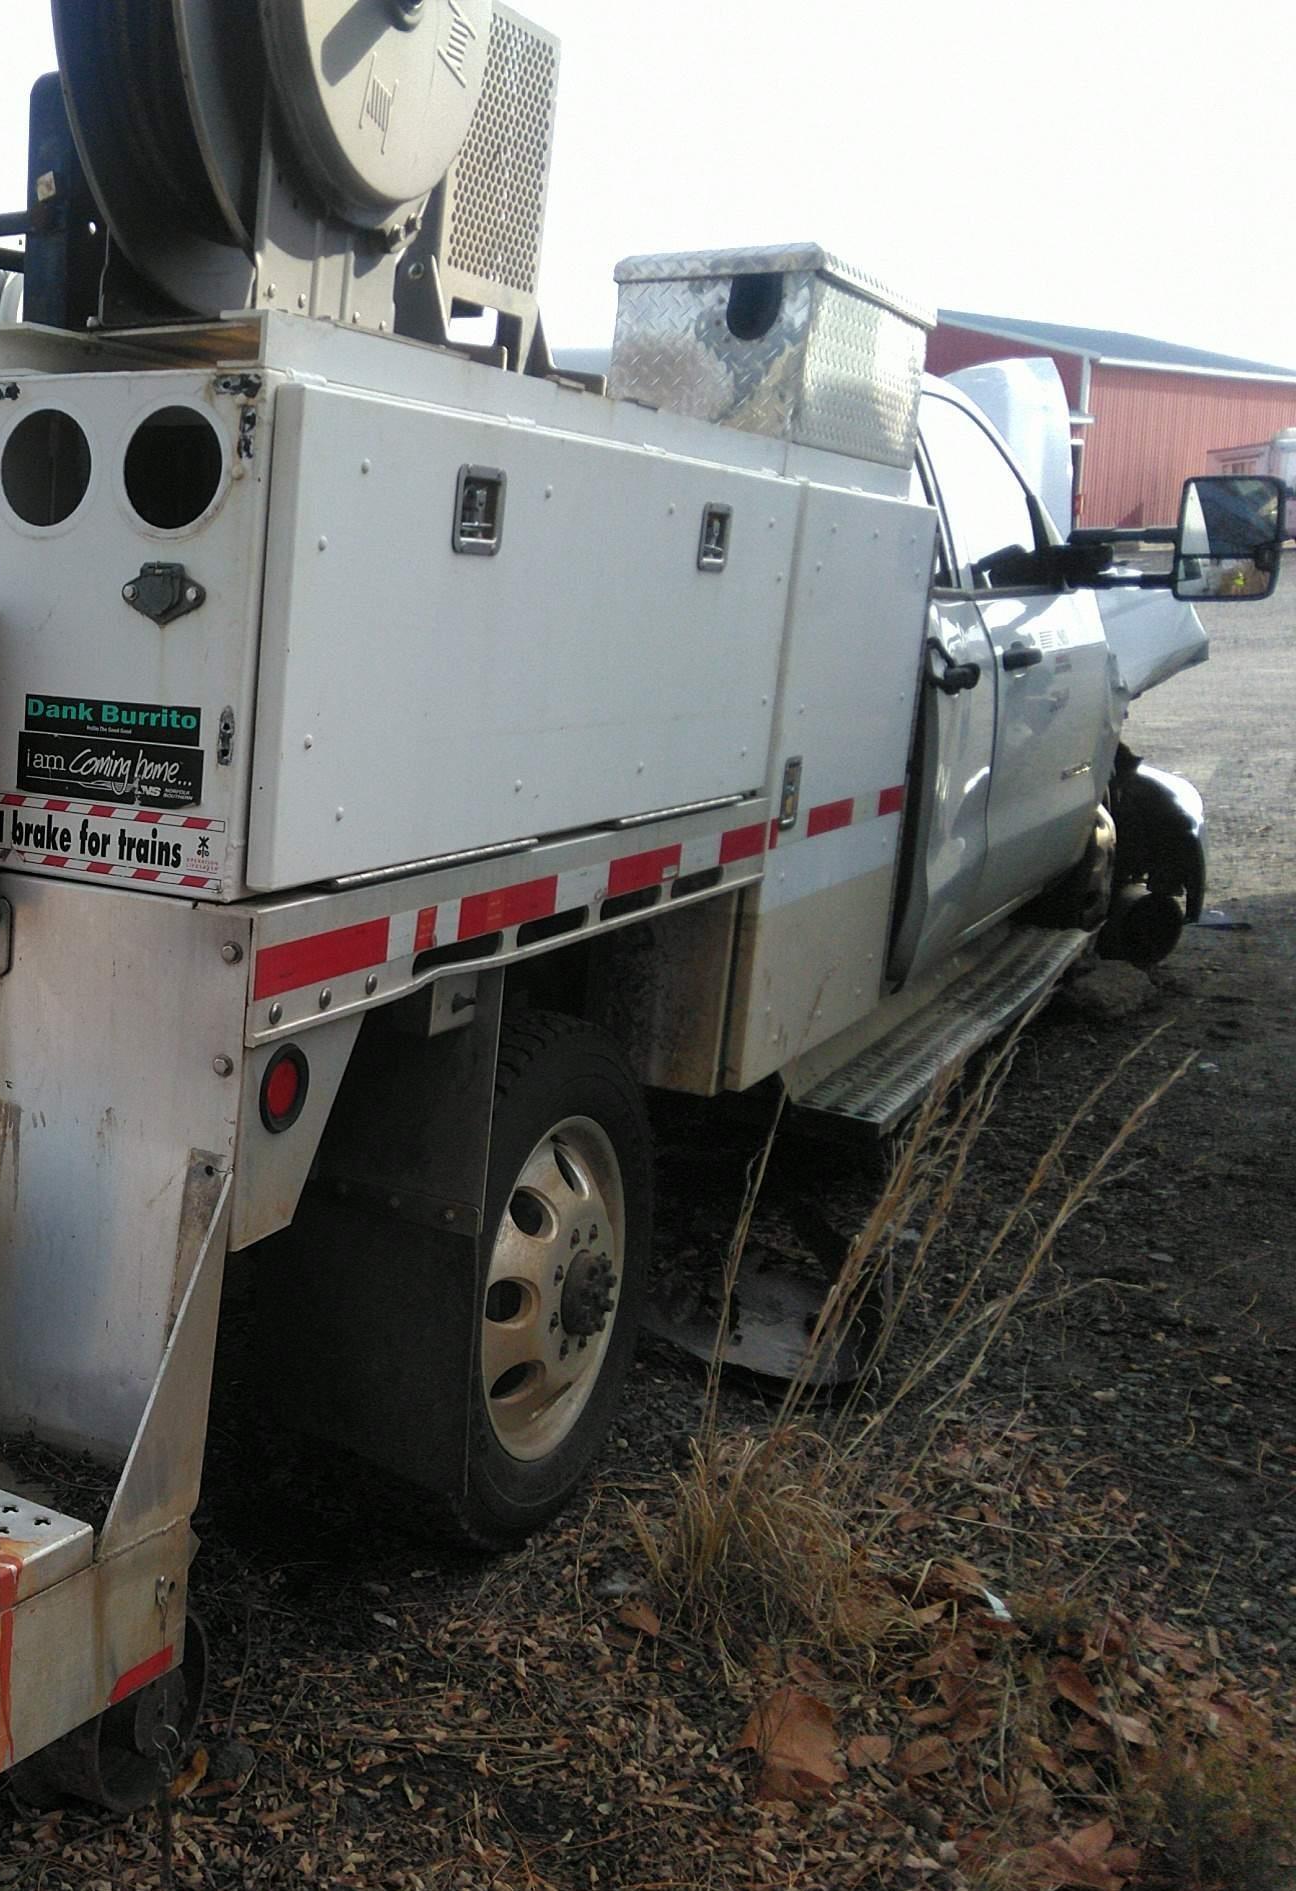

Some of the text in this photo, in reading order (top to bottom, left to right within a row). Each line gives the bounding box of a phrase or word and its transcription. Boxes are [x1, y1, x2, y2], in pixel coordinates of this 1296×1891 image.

[27, 698, 197, 730] Dank Burrito
[33, 753, 66, 771] am
[12, 810, 72, 853] brake
[80, 818, 111, 857] for
[119, 827, 181, 869] trains
